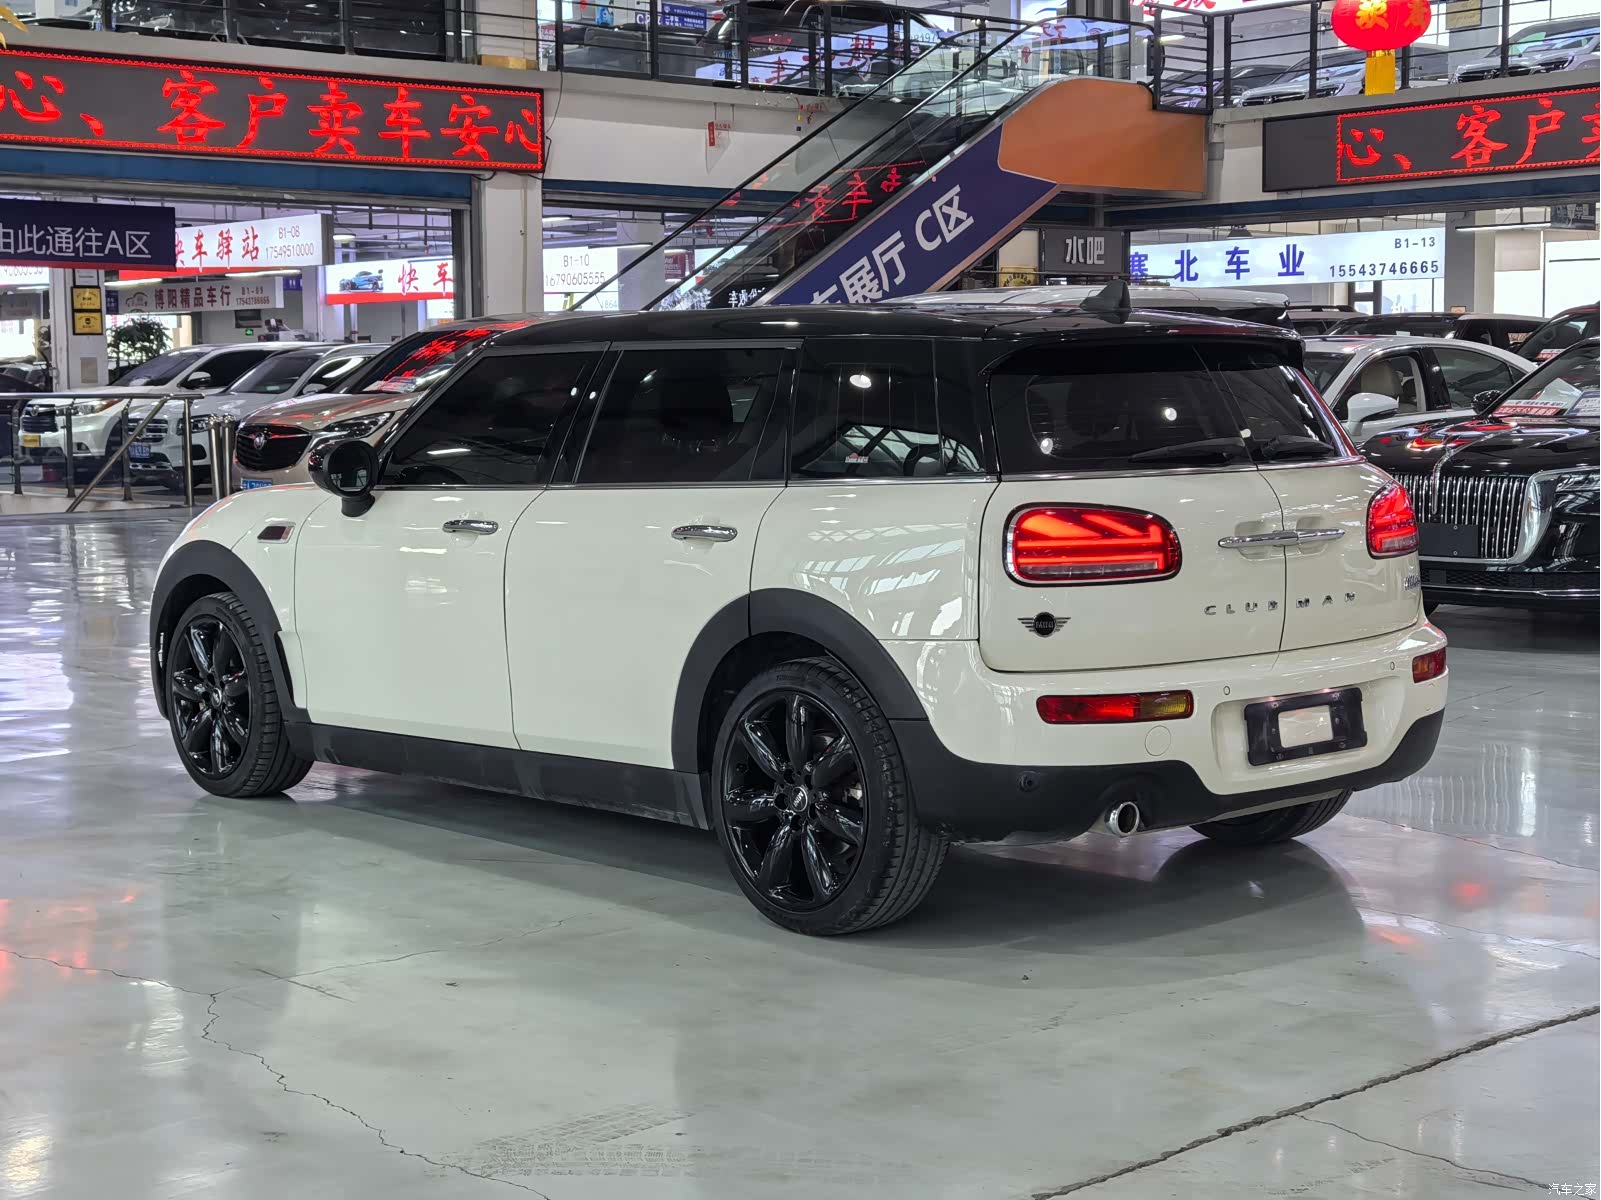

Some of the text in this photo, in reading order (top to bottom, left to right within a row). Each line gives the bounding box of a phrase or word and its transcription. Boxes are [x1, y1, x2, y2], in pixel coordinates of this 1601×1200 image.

[914, 184, 975, 252] C区
[278, 225, 301, 239] B1-08
[1065, 236, 1105, 265] 水吧
[1394, 237, 1436, 250] B1-13
[563, 254, 590, 268] B1-10
[1329, 260, 1440, 278] 15543746665
[154, 285, 231, 310] 博阳精品车行
[1204, 592, 1356, 616] CLUBMAN
